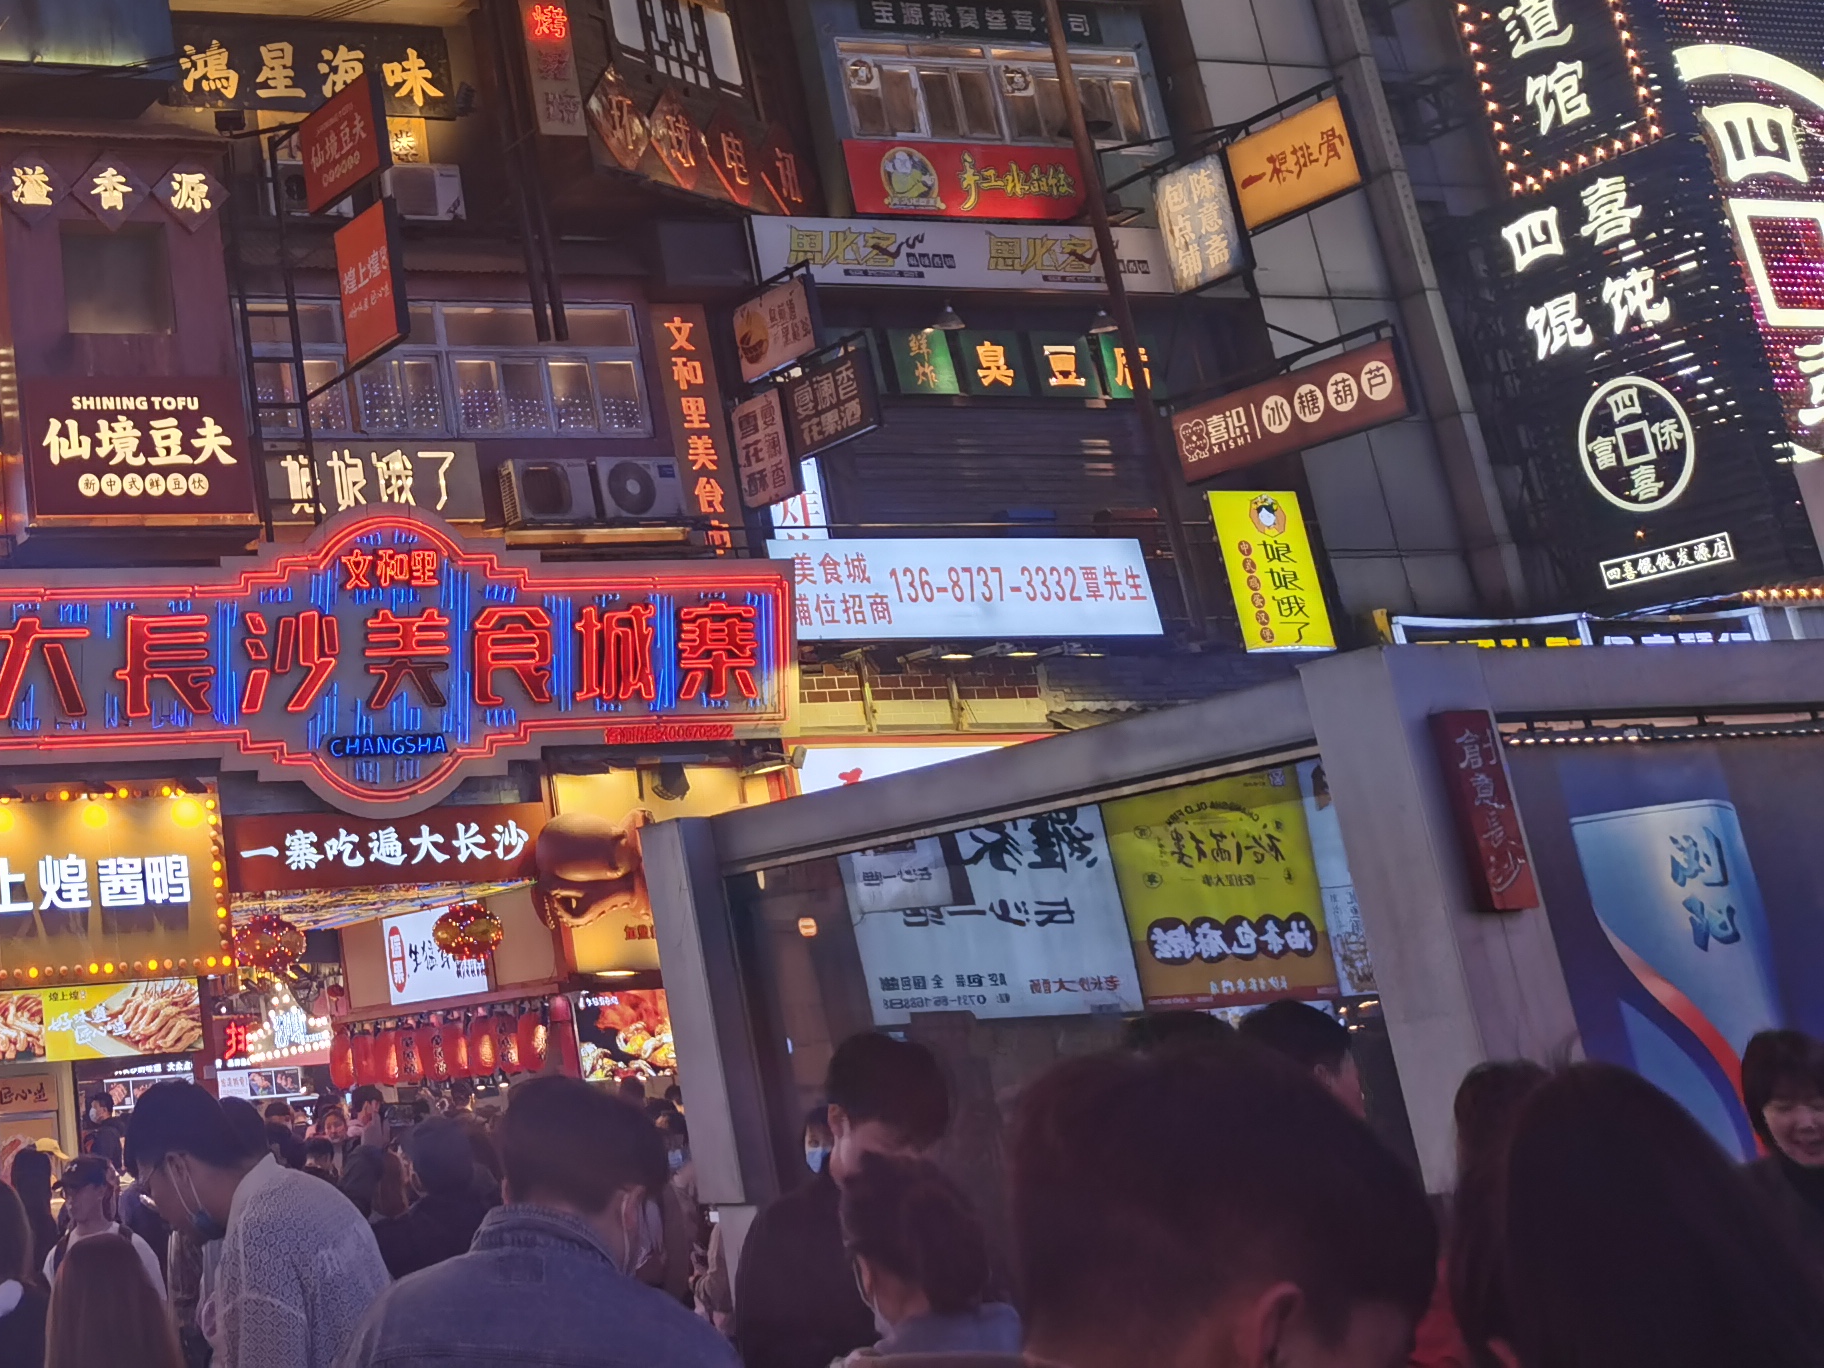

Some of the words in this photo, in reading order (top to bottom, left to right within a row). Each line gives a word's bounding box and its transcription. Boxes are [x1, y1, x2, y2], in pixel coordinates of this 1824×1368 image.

[179, 39, 445, 108] 鴻星海味
[1241, 126, 1345, 190] 一根排骨
[12, 165, 213, 213] 溢香源
[1188, 169, 1231, 269] 陈意斋
[1502, 176, 1642, 272] 四喜
[1526, 268, 1671, 363] 馄饨
[71, 394, 148, 412] SHINING
[151, 395, 200, 412] TOFU
[793, 359, 860, 417] 宴澜香
[1265, 364, 1389, 429] 冰糖葫芦
[1606, 386, 1641, 419] 四
[42, 415, 238, 466] 仙境豆夫
[800, 394, 862, 448] 花果酒
[1206, 405, 1247, 445] 喜识
[1651, 418, 1684, 453] 侨
[1212, 435, 1253, 455] XISHI
[1587, 435, 1618, 471] 富
[1630, 464, 1665, 502] 喜
[340, 547, 440, 590] 文和里
[790, 552, 872, 586] 美食城
[1606, 538, 1733, 583] 四喜馄饨发源店
[888, 565, 1080, 604] 136-8737-3332
[1080, 565, 1148, 603] 覃先生
[1258, 538, 1312, 644] 娘娘饿了
[329, 734, 449, 759] CHANGSHA
[241, 819, 531, 870] 一寨吃遍大长沙
[48, 989, 79, 1002] 煌上煌
